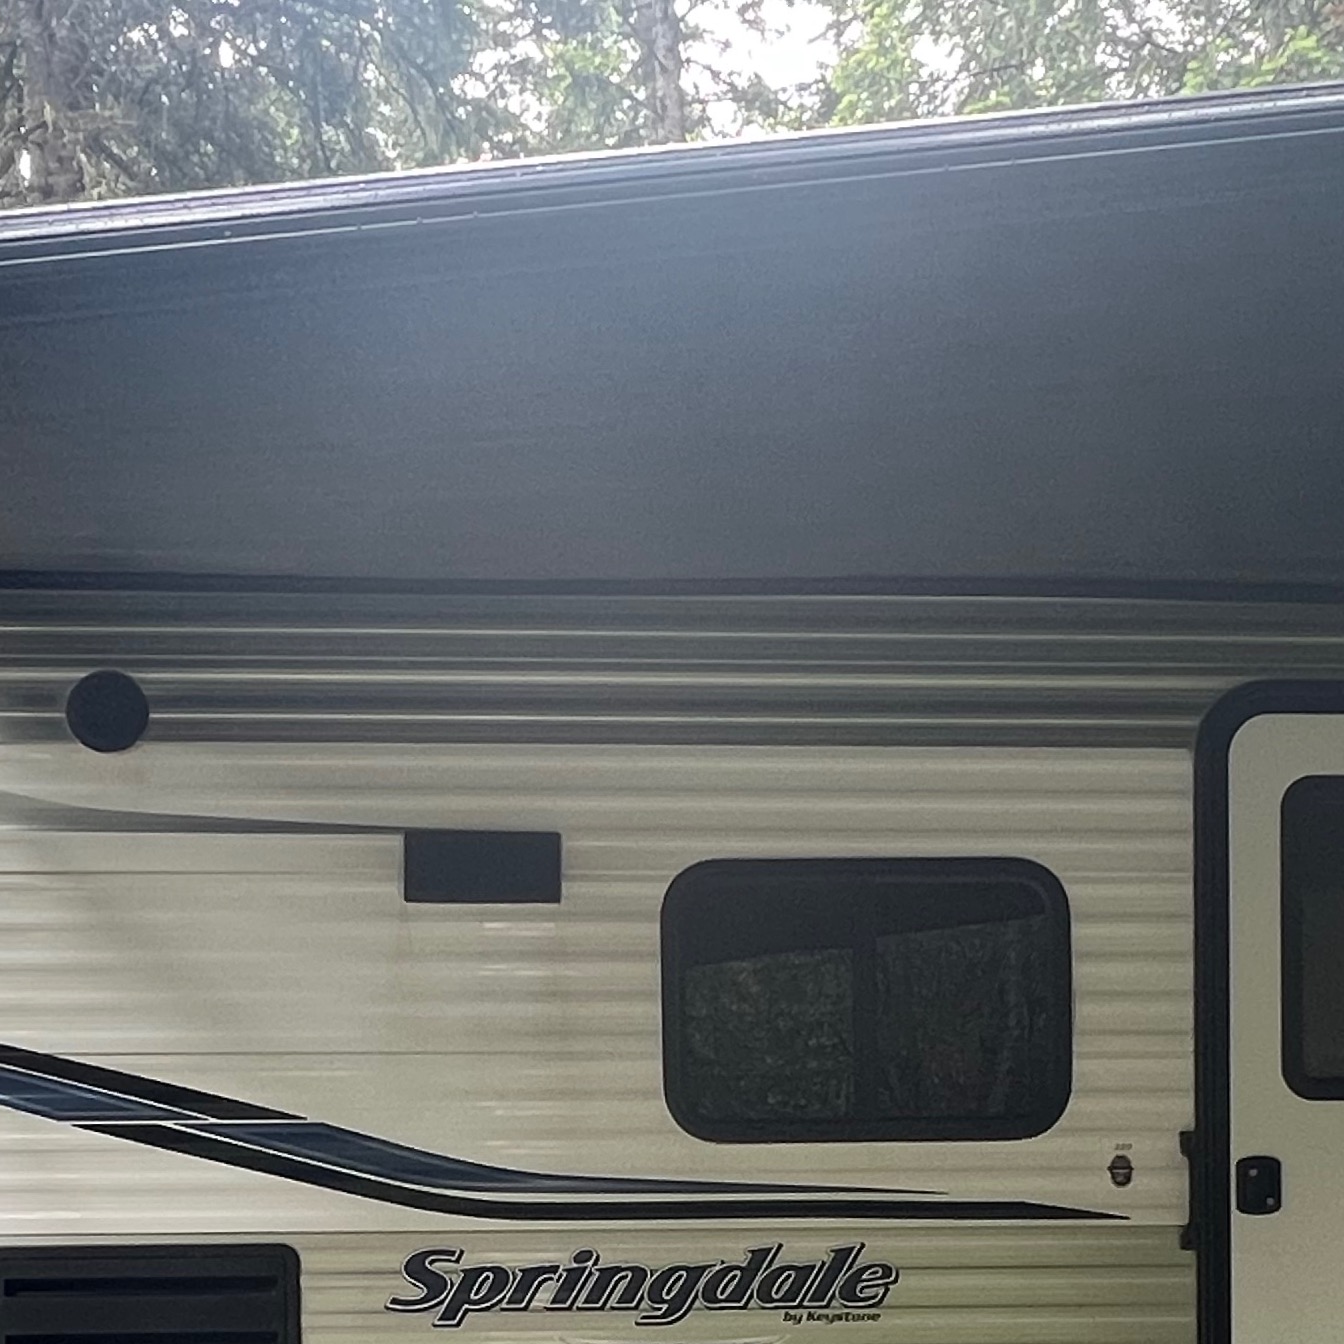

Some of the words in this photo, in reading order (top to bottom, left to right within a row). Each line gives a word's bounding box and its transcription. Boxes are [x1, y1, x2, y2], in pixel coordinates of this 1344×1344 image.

[385, 1242, 899, 1327] Springdale
[782, 1311, 803, 1325] by
[806, 1311, 882, 1325] Keystone
